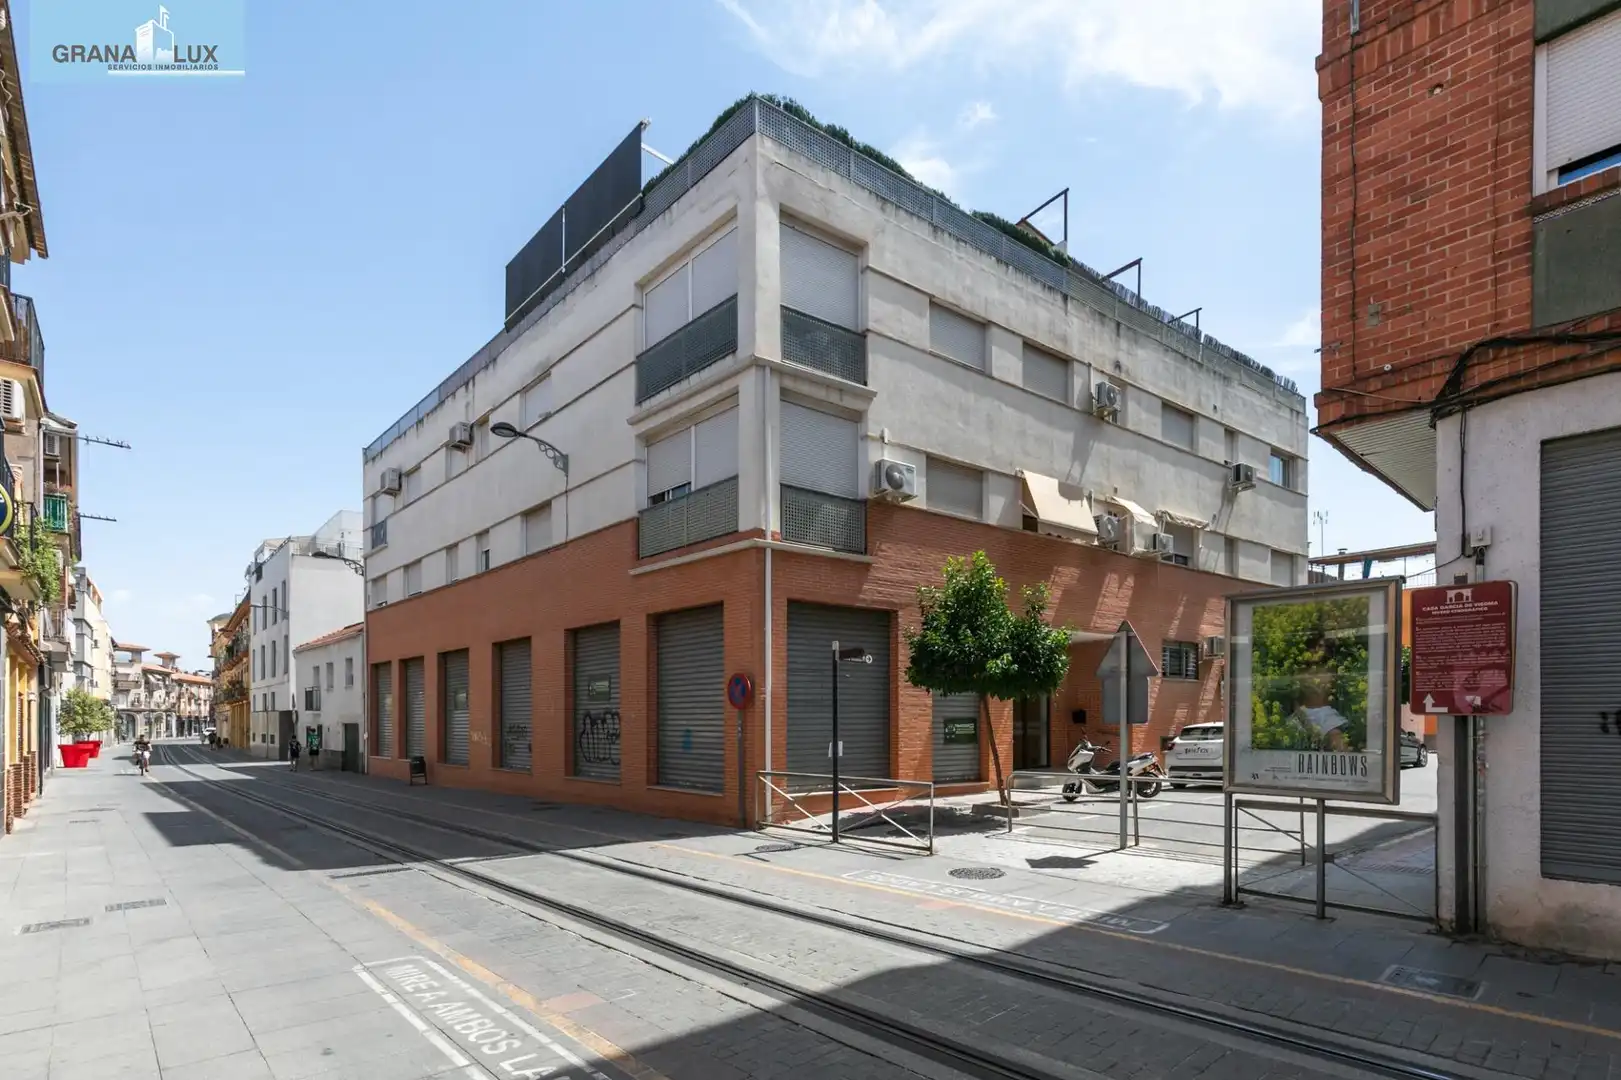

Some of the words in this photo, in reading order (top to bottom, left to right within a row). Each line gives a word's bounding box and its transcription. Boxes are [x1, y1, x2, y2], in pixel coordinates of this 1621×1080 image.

[1298, 753, 1367, 777] RAINBOWS
[386, 964, 438, 993] MIRE
[415, 990, 448, 1003] A
[429, 1001, 522, 1055] AMBOS
[499, 1053, 571, 1080] LA
